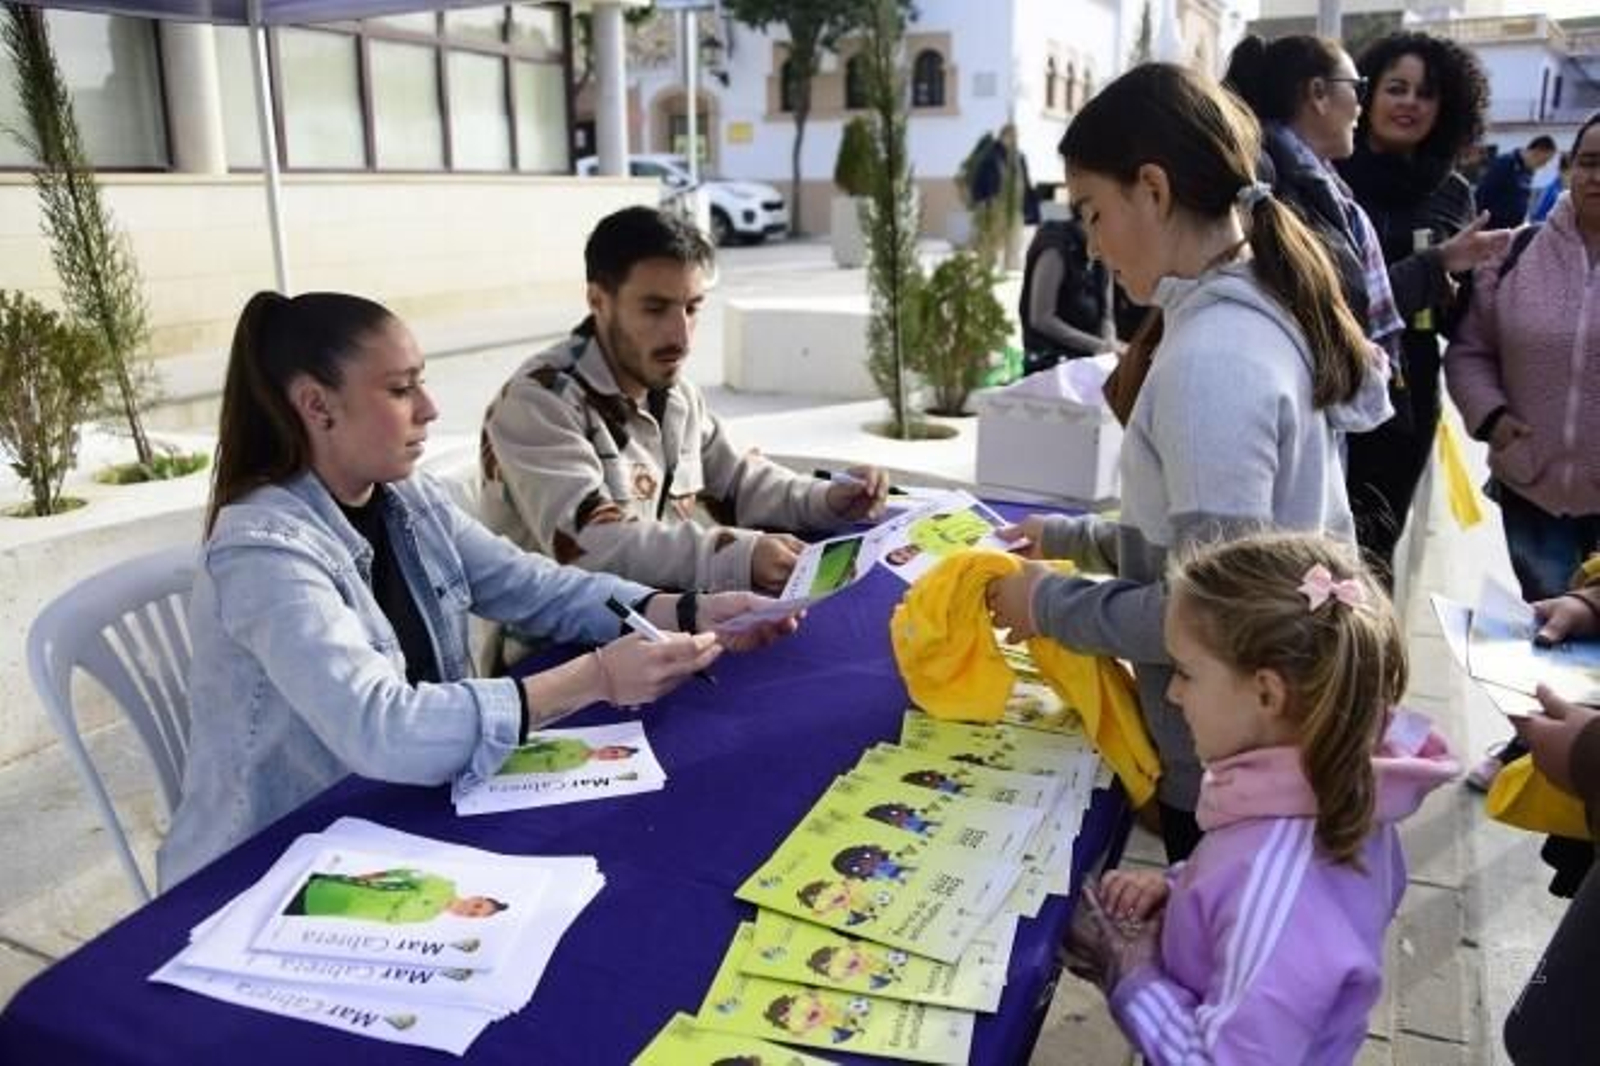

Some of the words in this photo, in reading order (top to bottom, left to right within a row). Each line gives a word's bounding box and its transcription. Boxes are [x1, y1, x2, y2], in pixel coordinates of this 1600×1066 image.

[572, 777, 610, 787] Mar
[302, 929, 390, 950] Cabrera
[396, 938, 445, 955] Mar
[381, 968, 435, 984] Mar
[235, 982, 324, 1012] Cabrera
[327, 1004, 379, 1028] Mar
